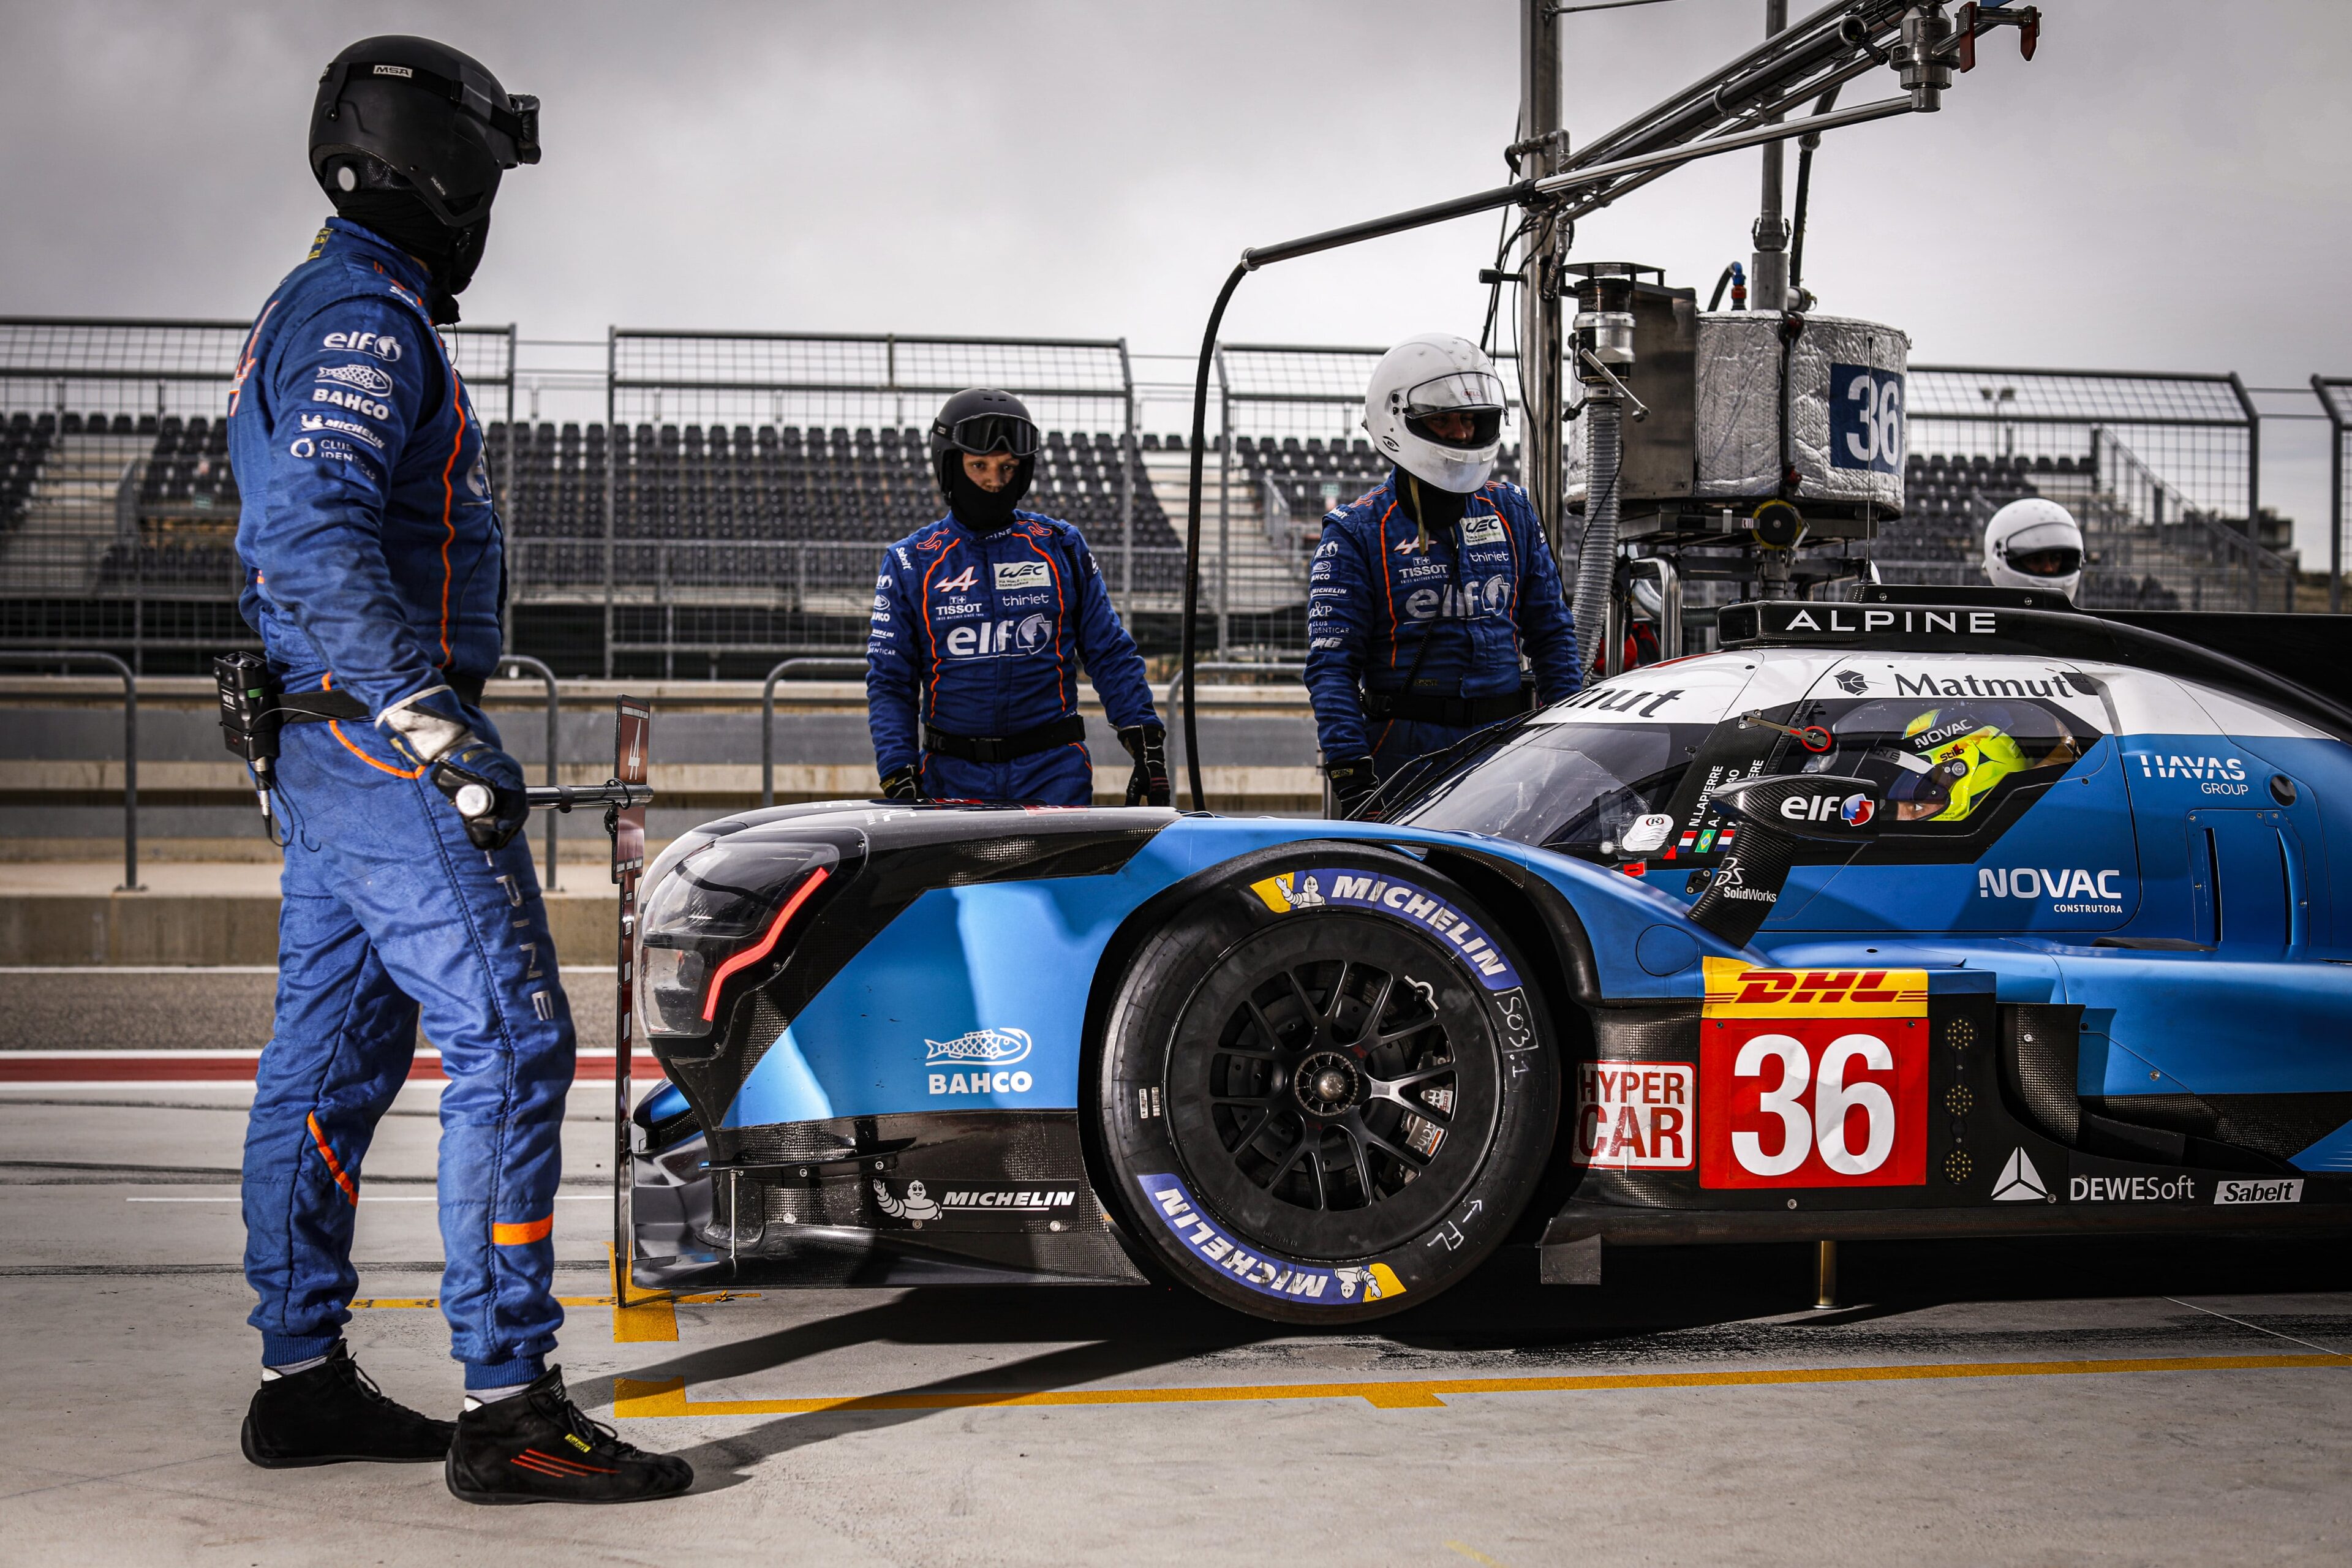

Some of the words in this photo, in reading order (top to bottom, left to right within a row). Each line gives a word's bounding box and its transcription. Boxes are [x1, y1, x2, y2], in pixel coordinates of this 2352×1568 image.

[375, 67, 409, 76] MSA
[323, 331, 377, 350] elf
[312, 388, 389, 420] BAHCO
[1847, 374, 1899, 466] 36
[325, 418, 386, 449] MICHELIN
[896, 547, 911, 570] Sabelt
[1470, 551, 1509, 563] thiriet
[998, 564, 1044, 578] WEC
[1399, 564, 1447, 579] TISSOT
[935, 603, 982, 616] TISSOT
[1002, 593, 1049, 606] thiriet
[1406, 581, 1480, 619] elf
[1785, 609, 1997, 634] ALPINE
[948, 620, 1014, 656] elf
[1894, 673, 2074, 698] Matmut
[1915, 719, 1972, 748] NOVAC
[1689, 765, 1724, 827] N.LAPIERRE
[2201, 782, 2248, 796] GROUP
[1780, 795, 1841, 821] elf
[1724, 886, 1777, 903] SolidWorks
[1979, 868, 2122, 899] NOVAC
[2053, 904, 2123, 913] CONSTRUTORA
[1330, 875, 1509, 978] MICHELIN
[1735, 971, 1896, 1004] DHL
[929, 1071, 1033, 1095] BAHCO
[1581, 1071, 1686, 1104] HYPER
[1731, 1032, 1896, 1177] 36
[1578, 1104, 1686, 1159] CAR
[942, 1189, 1076, 1208] MICHELIN
[2070, 1175, 2195, 1202] DEWESoft
[2224, 1182, 2294, 1202] Sabelt
[1154, 1186, 1329, 1298] MICHELIN
[1427, 1221, 1465, 1253] FL
